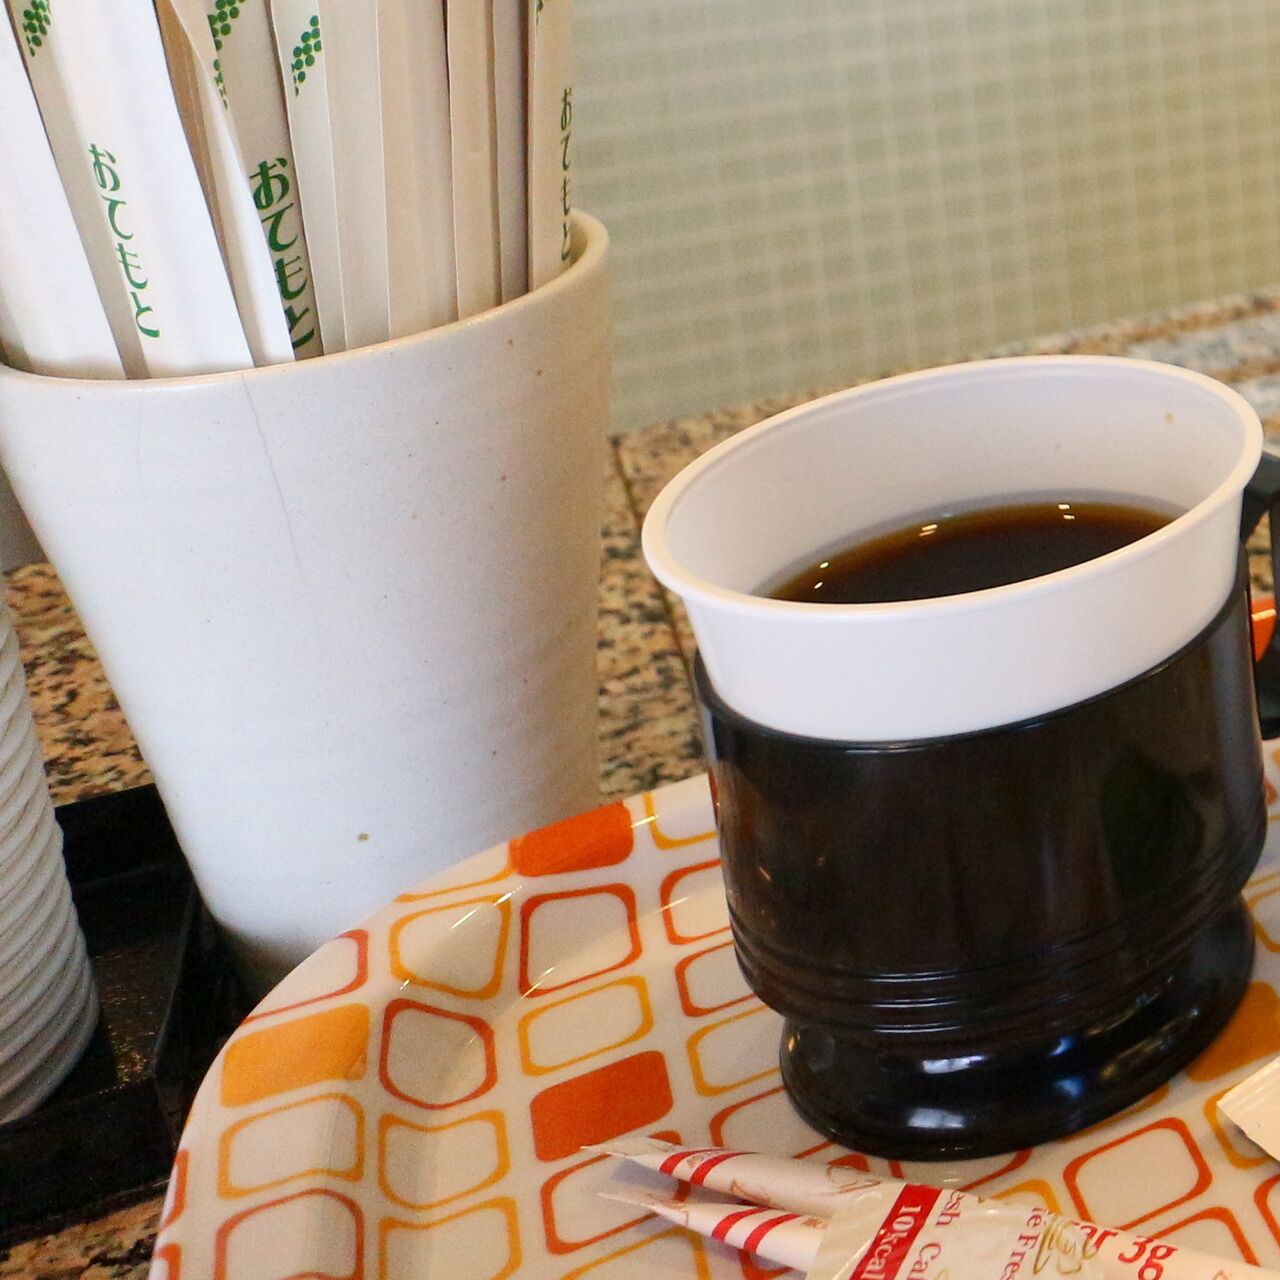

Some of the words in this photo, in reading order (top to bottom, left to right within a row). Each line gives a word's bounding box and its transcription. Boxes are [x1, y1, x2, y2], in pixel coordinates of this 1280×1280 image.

[88, 143, 161, 339] おてもと
[250, 157, 315, 350] おてもと
